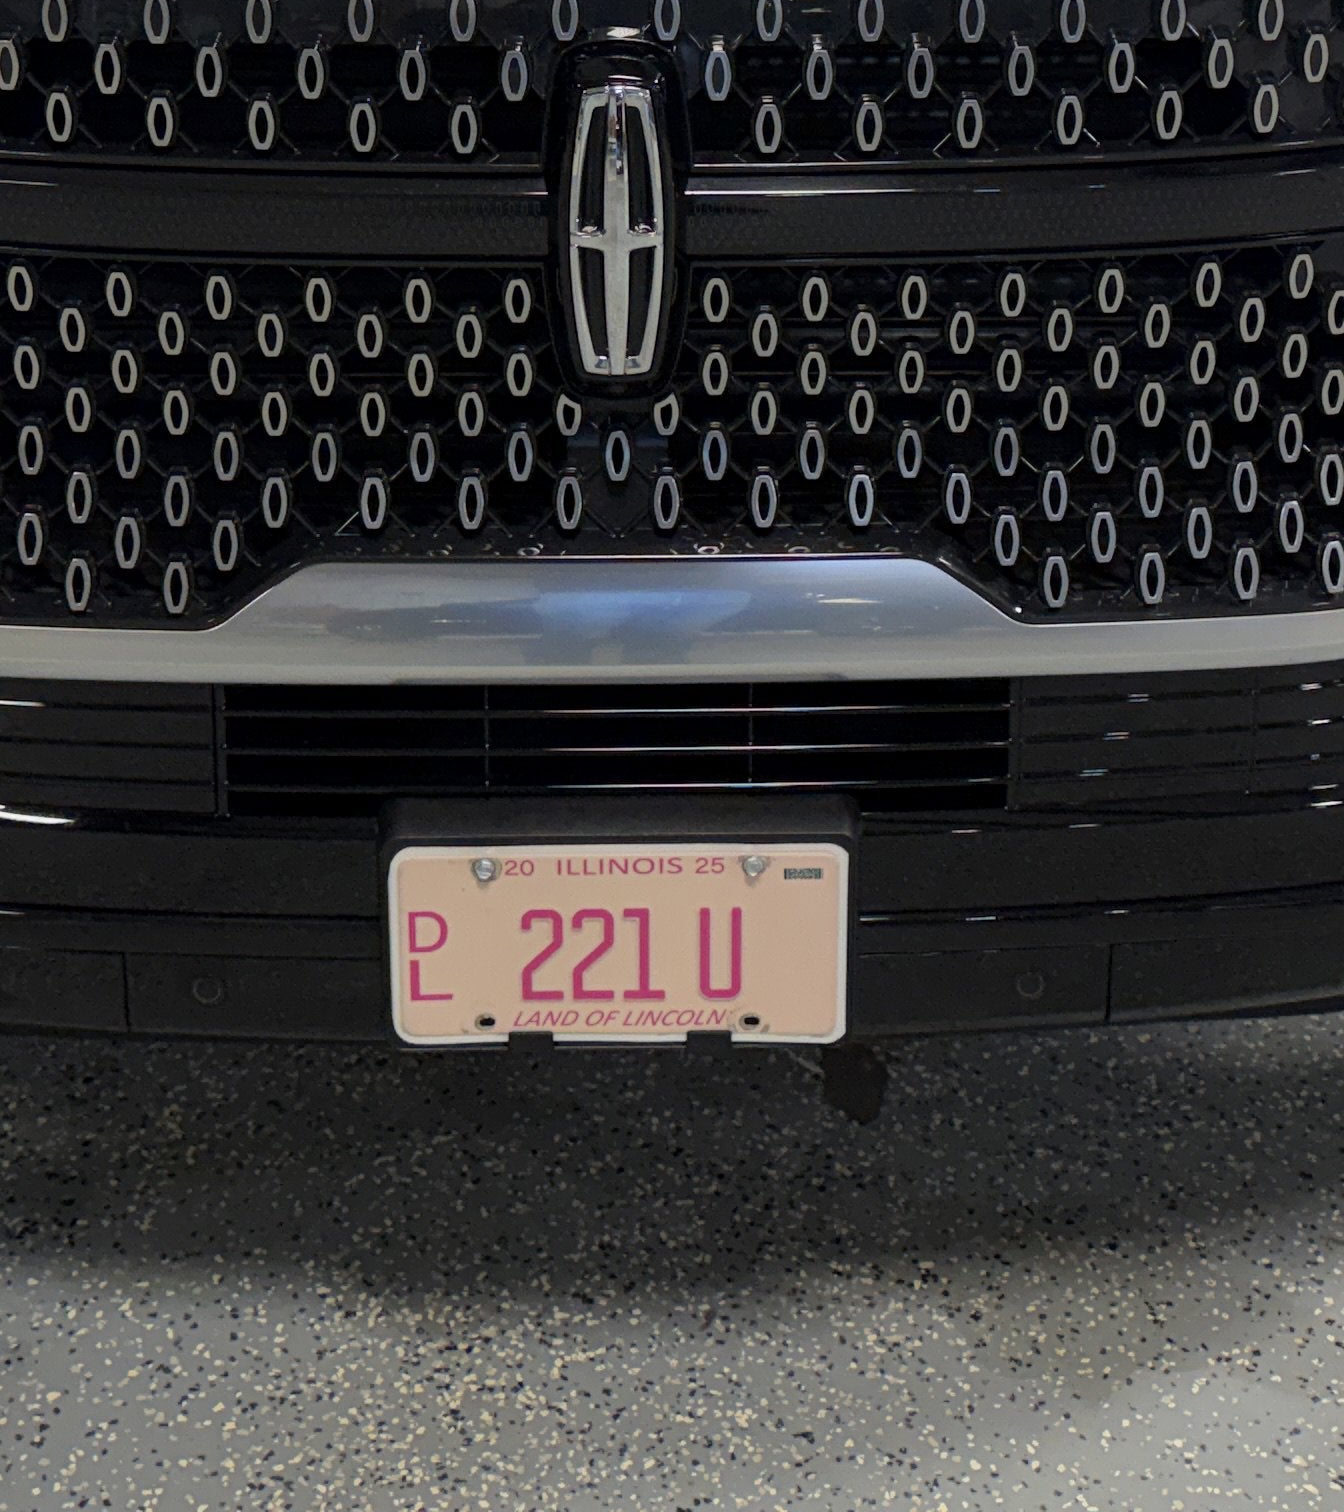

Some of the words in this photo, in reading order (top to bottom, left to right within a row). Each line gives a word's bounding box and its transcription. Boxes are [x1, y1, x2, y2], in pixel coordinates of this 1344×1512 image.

[505, 859, 535, 876] 20
[557, 857, 684, 876] ILLINOIS
[695, 856, 725, 874] 25
[520, 907, 666, 1002] 221
[699, 906, 742, 1000] U
[513, 1010, 580, 1027] LAND
[585, 1009, 620, 1026] OF
[622, 1008, 728, 1026] LINCOLN
